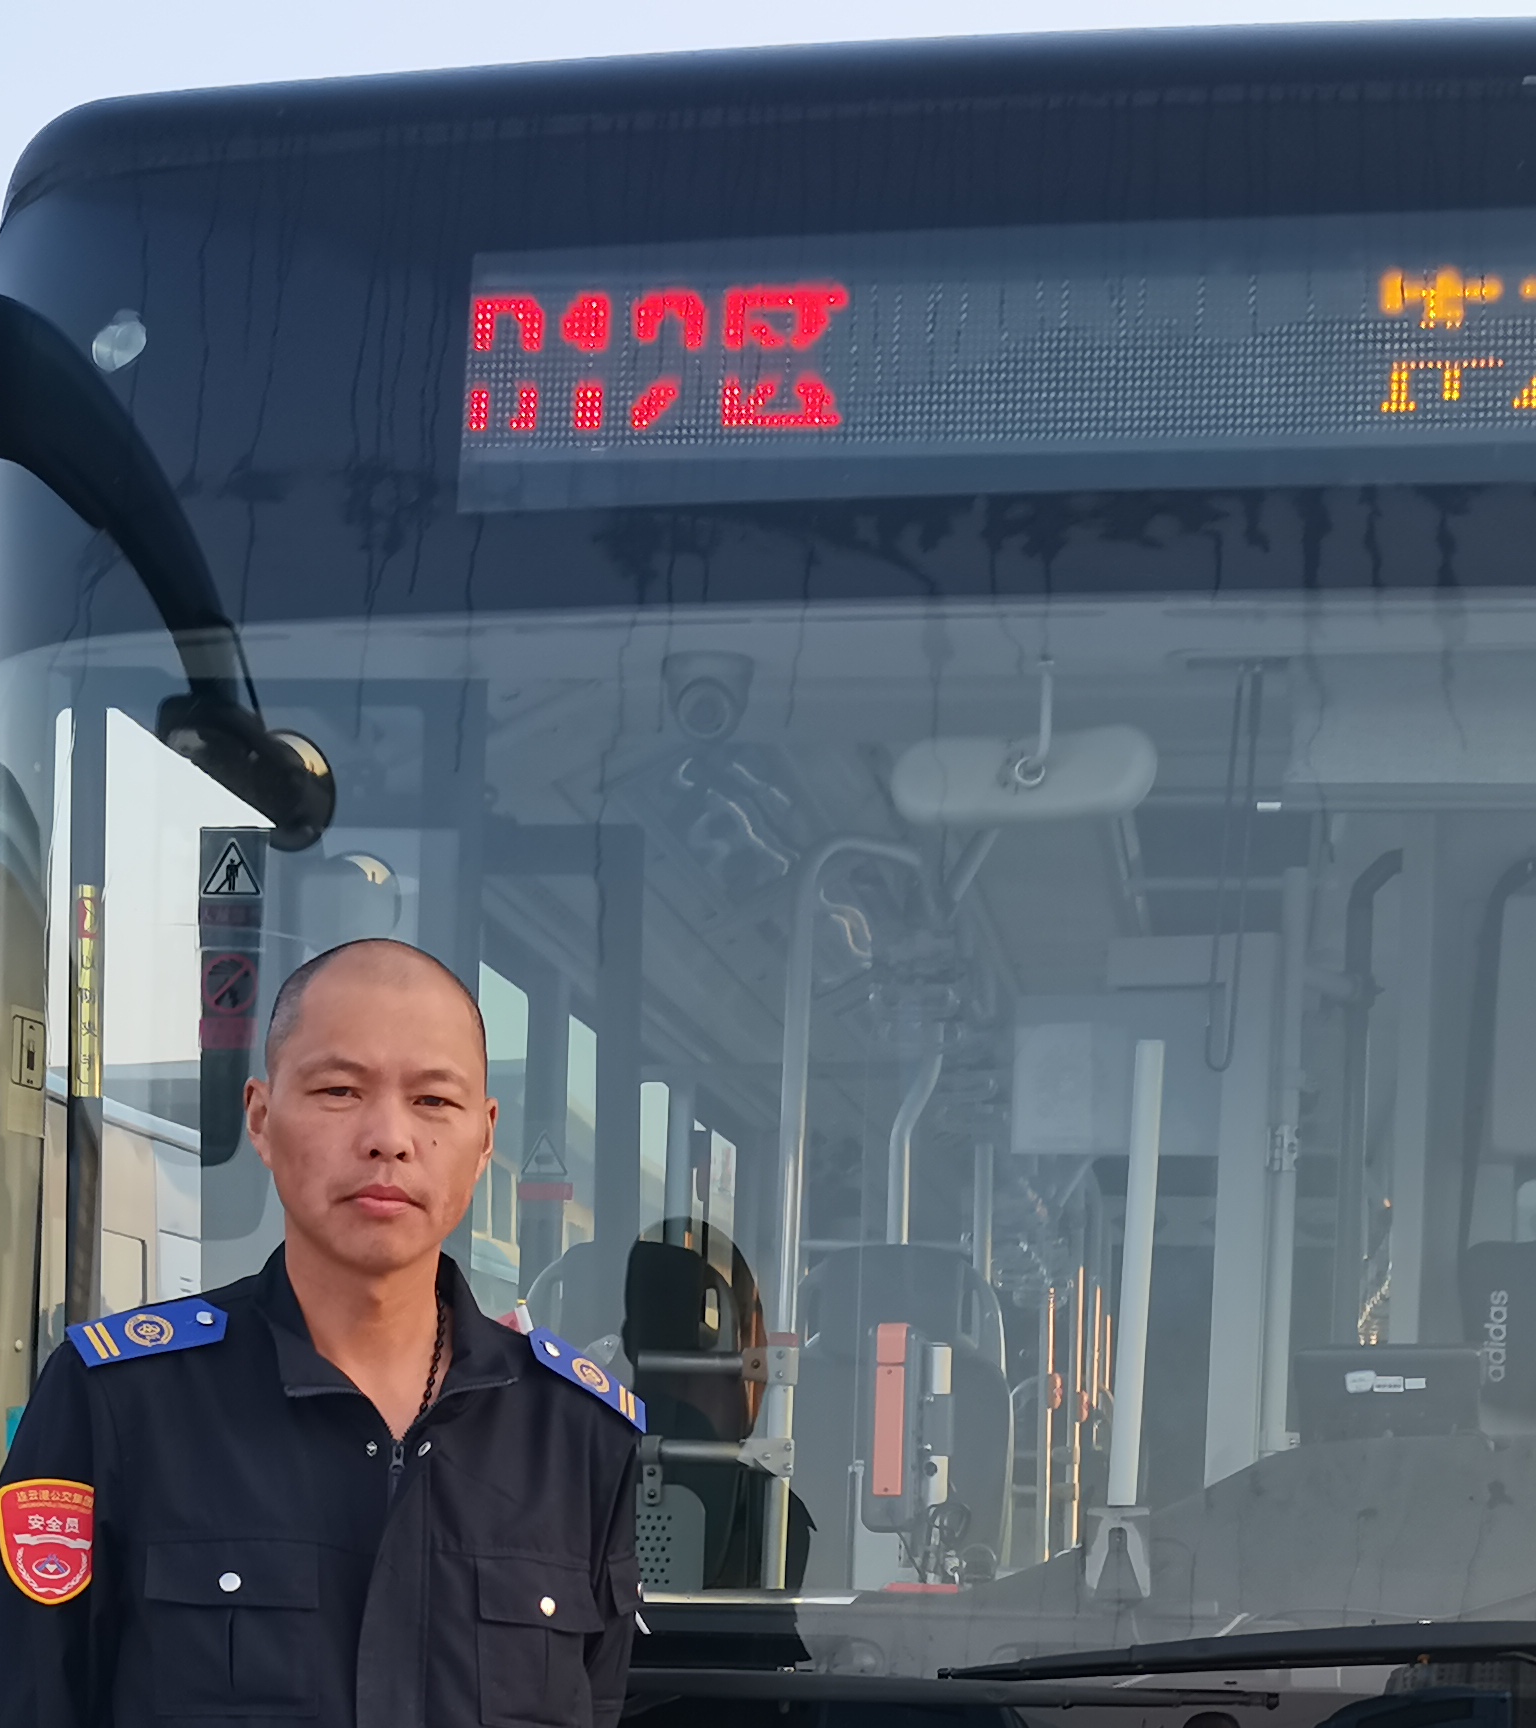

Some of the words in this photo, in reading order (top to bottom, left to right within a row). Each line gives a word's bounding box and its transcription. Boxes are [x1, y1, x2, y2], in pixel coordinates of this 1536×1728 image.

[1484, 1289, 1509, 1383] adidas
[27, 1514, 80, 1534] 安全员
